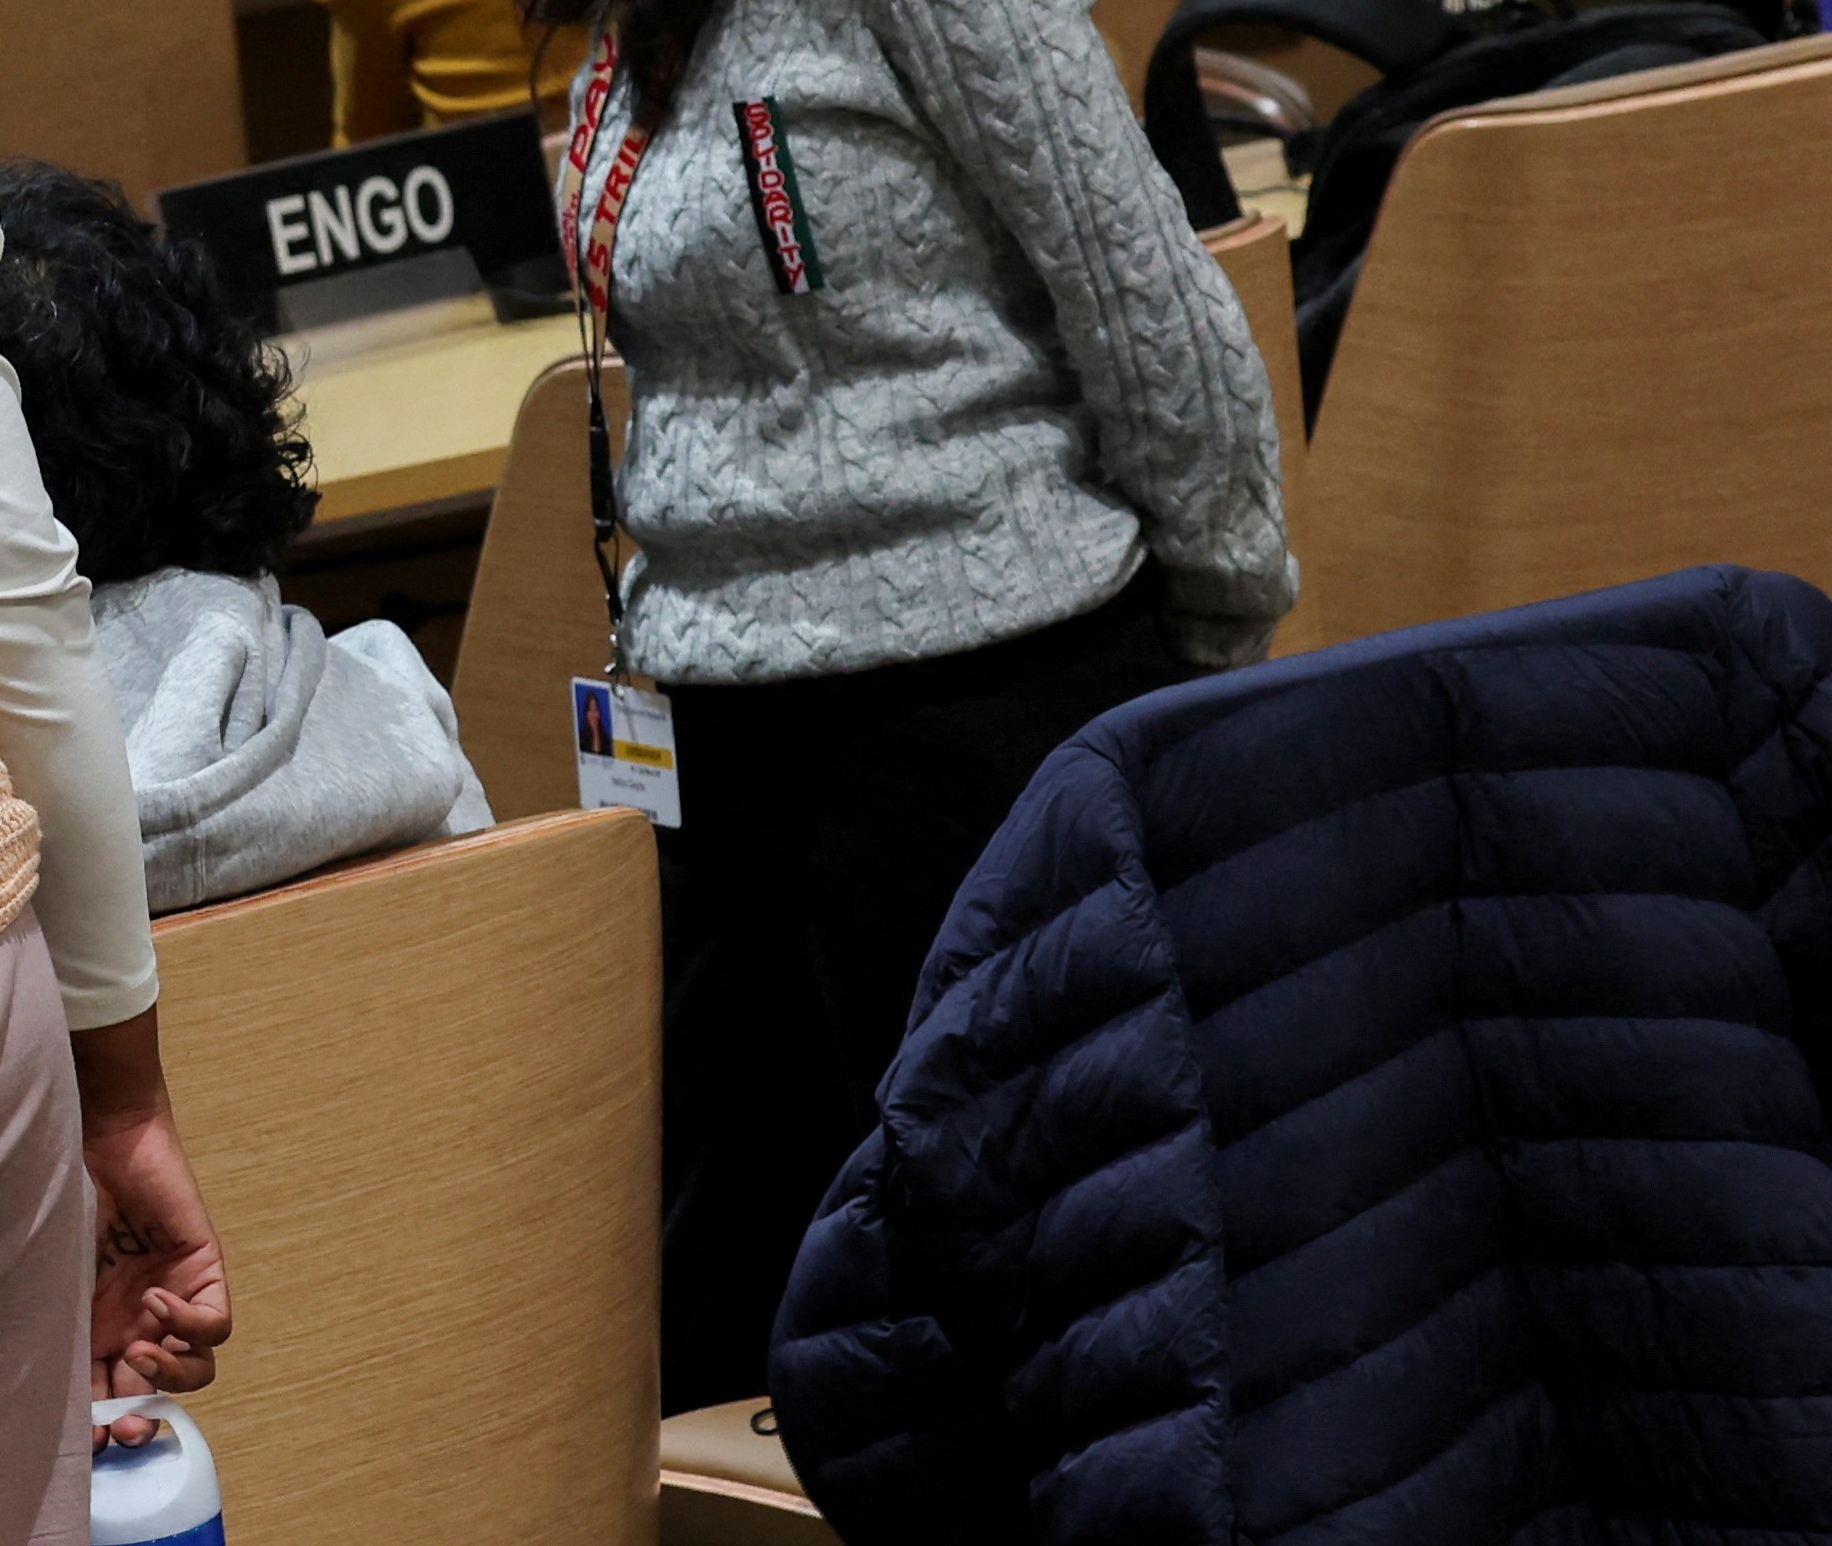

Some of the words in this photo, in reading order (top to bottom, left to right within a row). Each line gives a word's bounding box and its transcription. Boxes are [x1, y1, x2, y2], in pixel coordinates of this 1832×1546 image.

[569, 31, 617, 174] PAY
[267, 164, 455, 275] ENGO
[595, 131, 650, 226] TRIL
[744, 102, 805, 289] SOLIDARITY
